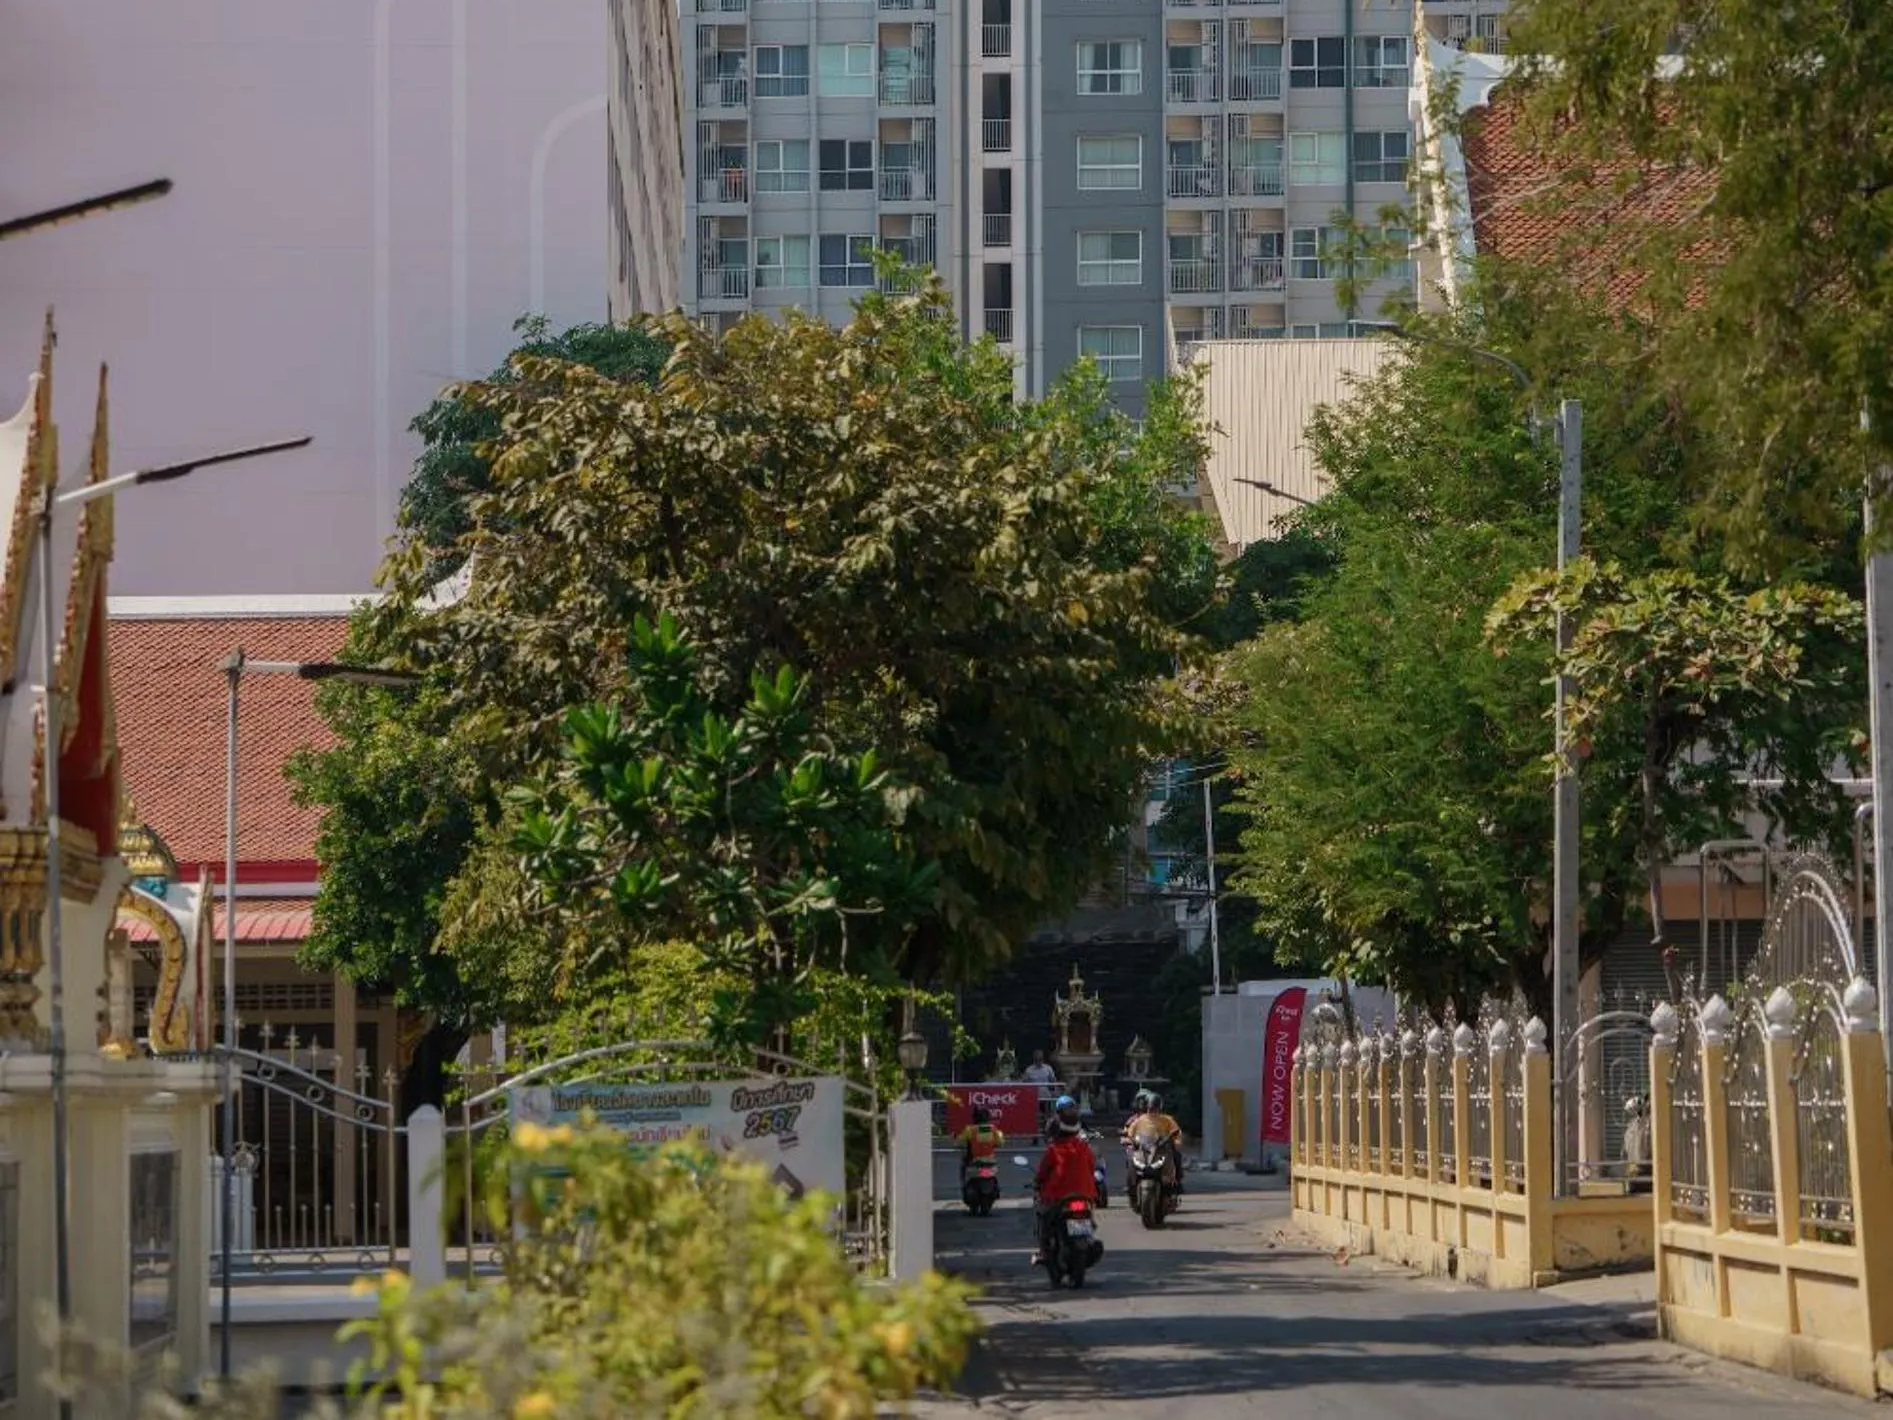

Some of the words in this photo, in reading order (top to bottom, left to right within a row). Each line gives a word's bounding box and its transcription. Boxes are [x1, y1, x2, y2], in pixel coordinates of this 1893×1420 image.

[1273, 1031, 1290, 1080] OPEN
[743, 1105, 802, 1139] 2567
[1271, 1084, 1286, 1130] NOW
